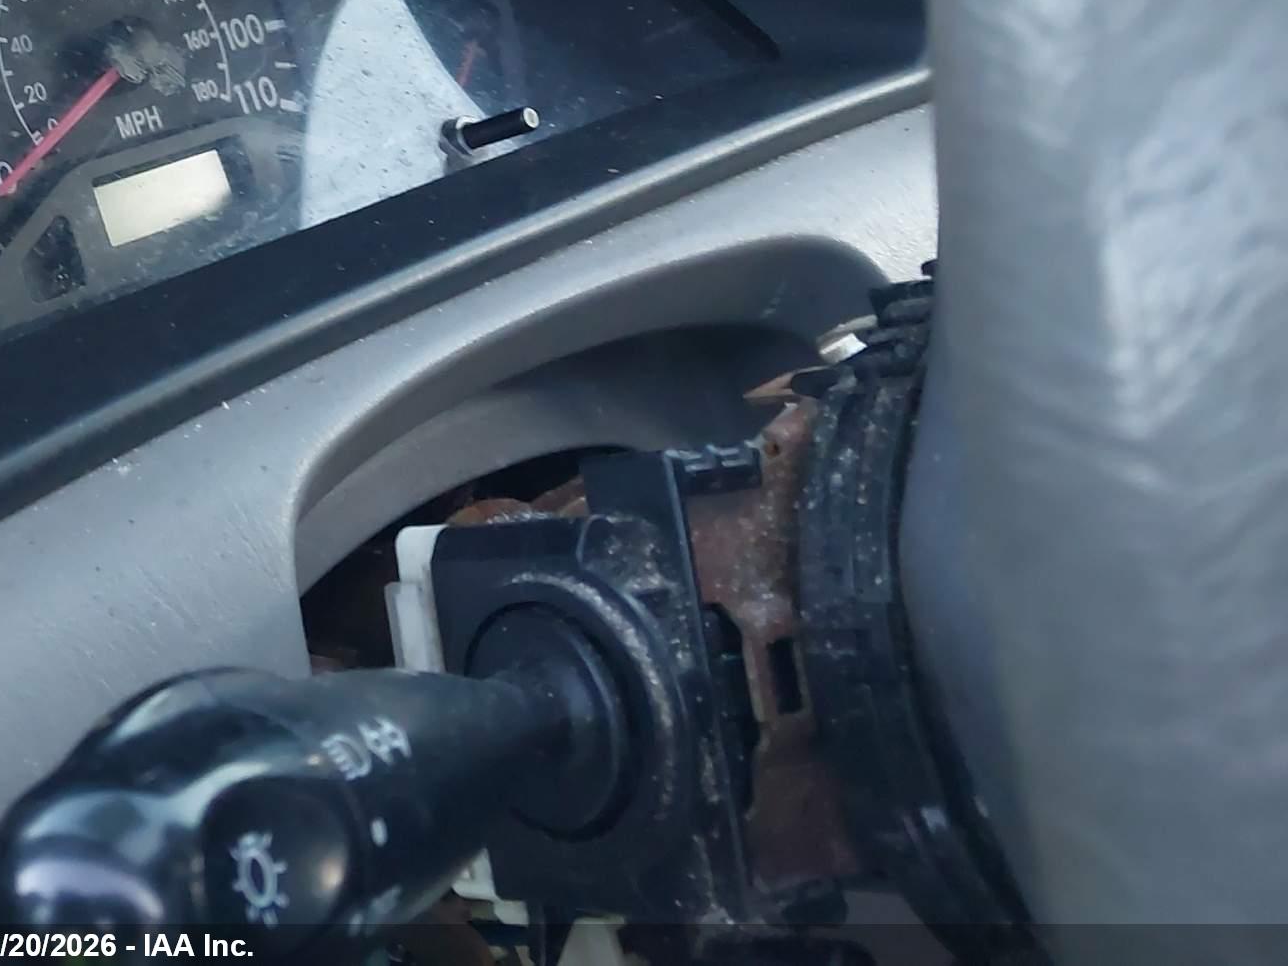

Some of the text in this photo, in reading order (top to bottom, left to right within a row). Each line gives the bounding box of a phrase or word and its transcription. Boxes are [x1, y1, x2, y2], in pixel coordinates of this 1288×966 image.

[11, 34, 34, 55] 40
[183, 31, 209, 52] 160
[218, 14, 265, 52] 100
[24, 81, 48, 105] 20
[191, 80, 219, 103] 180
[235, 76, 278, 115] 110
[115, 106, 163, 139] MPH
